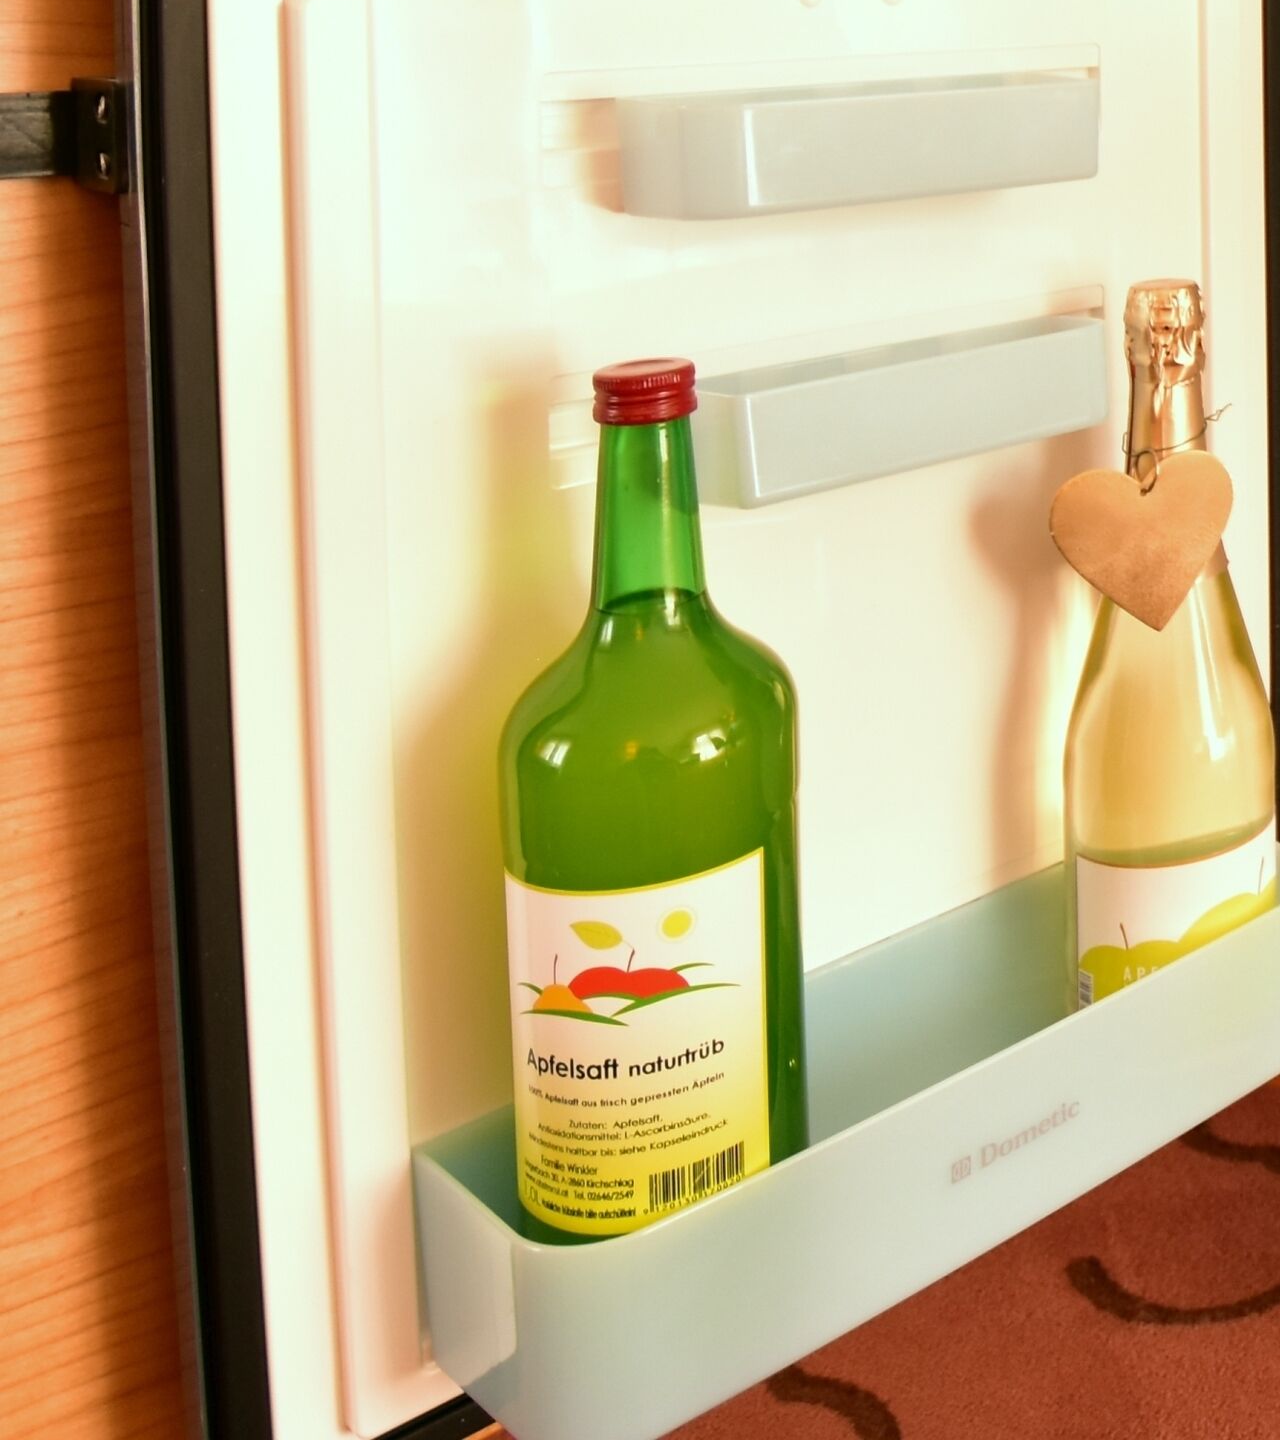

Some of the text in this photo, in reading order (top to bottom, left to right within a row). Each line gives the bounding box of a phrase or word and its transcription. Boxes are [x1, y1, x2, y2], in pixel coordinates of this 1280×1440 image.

[527, 1039, 725, 1080] Apfelsaft naturtrüb
[545, 1092, 579, 1106] Apfelsaft
[581, 1099, 597, 1108] aus
[600, 1097, 627, 1107] frisch
[630, 1086, 689, 1106] gepressten
[569, 1114, 663, 1130] Zutaten: Apfelsaft,
[566, 1145, 597, 1157] haltbar
[600, 1147, 616, 1157] bis:
[619, 1145, 646, 1155] siehe
[650, 1118, 728, 1149] Kapseleindruck
[980, 1101, 1080, 1168] Dometic
[541, 1154, 598, 1176] Familie Winkler
[586, 1179, 634, 1189] Kirchschlag
